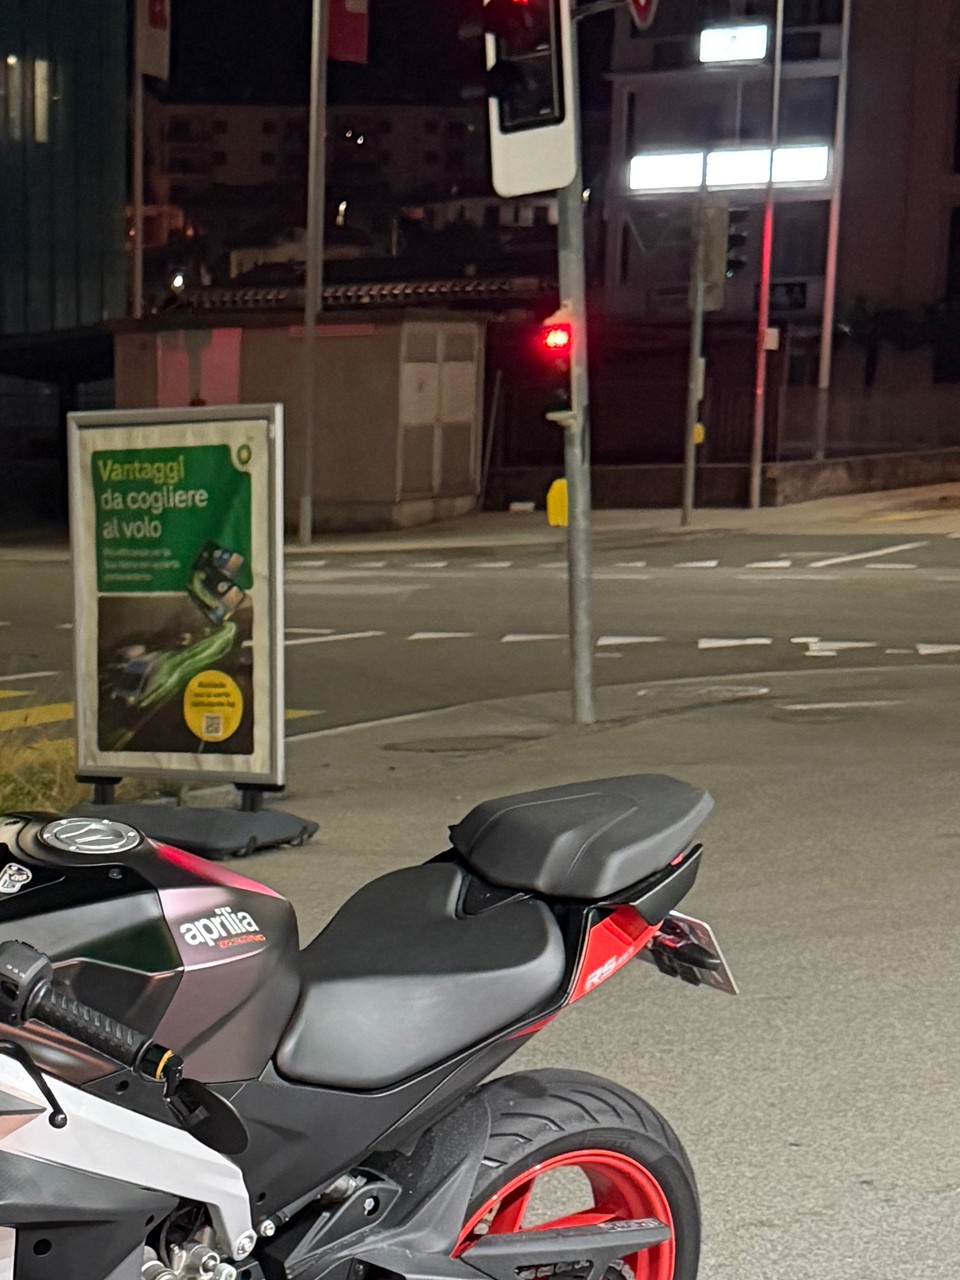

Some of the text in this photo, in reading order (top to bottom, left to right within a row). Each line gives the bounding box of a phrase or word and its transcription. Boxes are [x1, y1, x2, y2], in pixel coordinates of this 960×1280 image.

[98, 455, 184, 485] Vantaggi
[101, 486, 208, 514] da cogliere
[103, 516, 161, 539] al volo
[180, 906, 260, 947] aprilia
